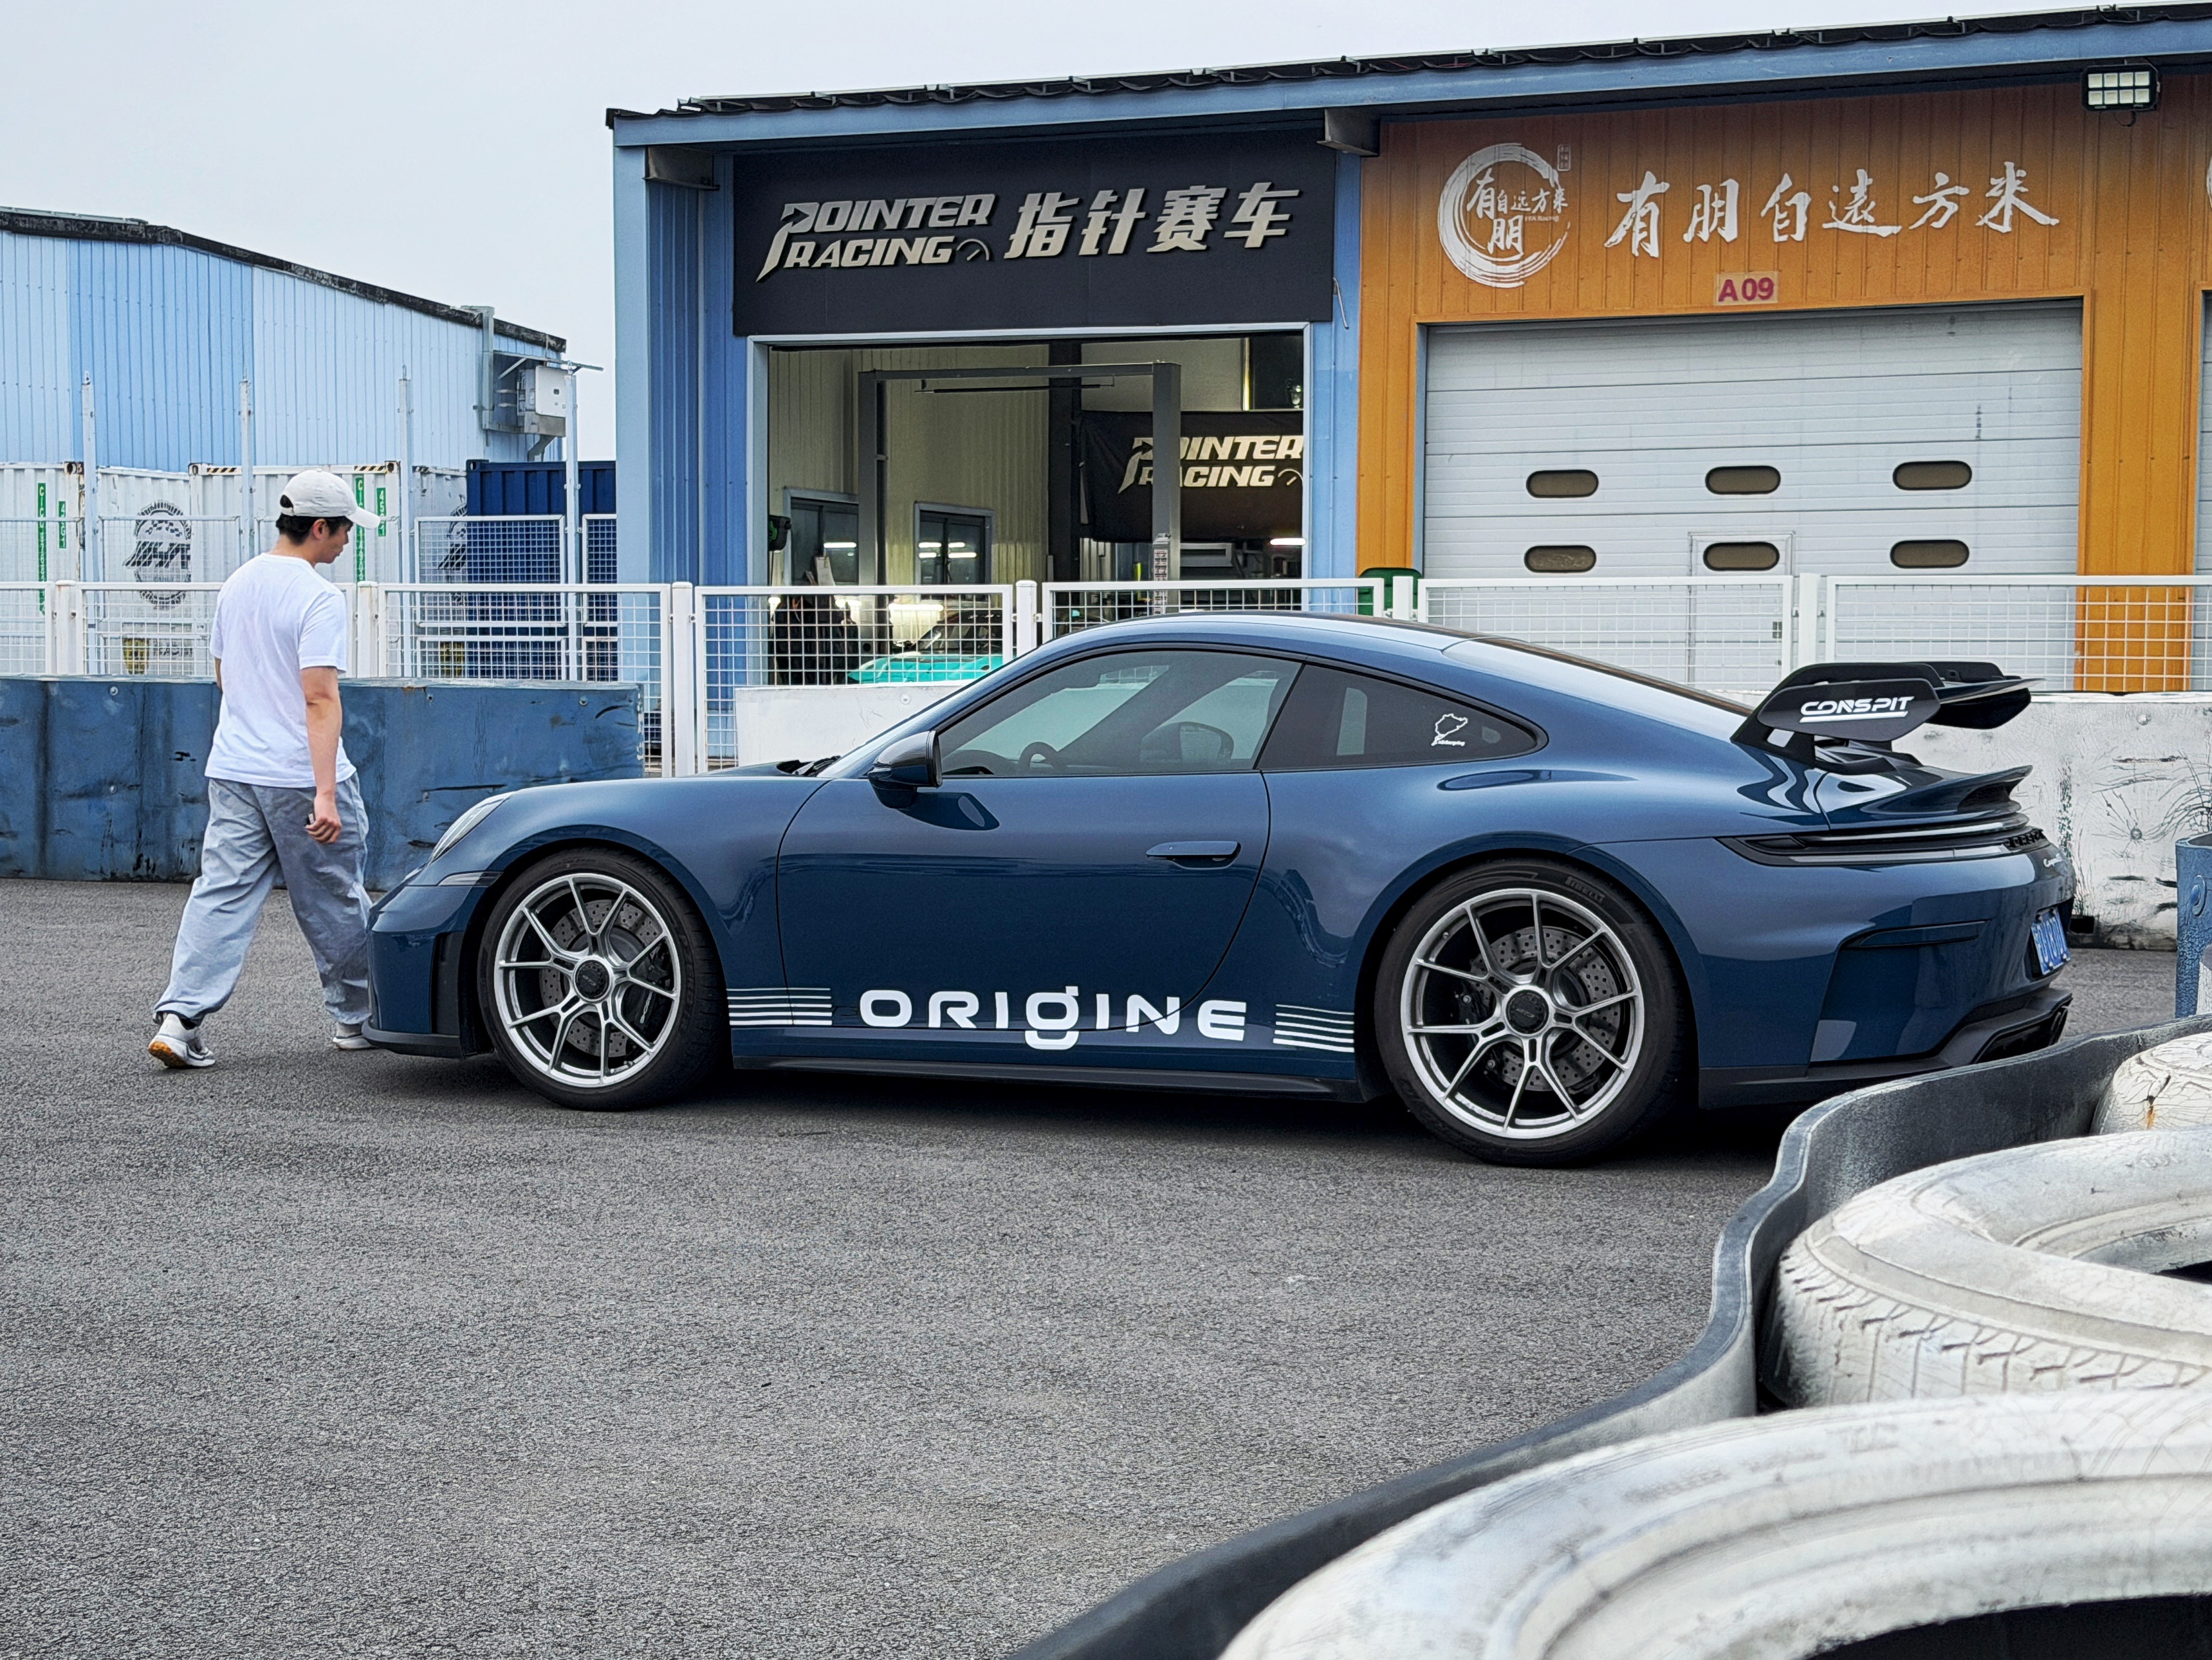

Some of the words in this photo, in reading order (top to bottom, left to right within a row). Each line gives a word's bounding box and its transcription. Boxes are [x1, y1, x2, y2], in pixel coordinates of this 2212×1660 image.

[1004, 181, 1300, 259] 指针赛车
[783, 235, 955, 268] RACING
[1718, 277, 1774, 302] A09
[1800, 696, 1915, 715] CONSPIT
